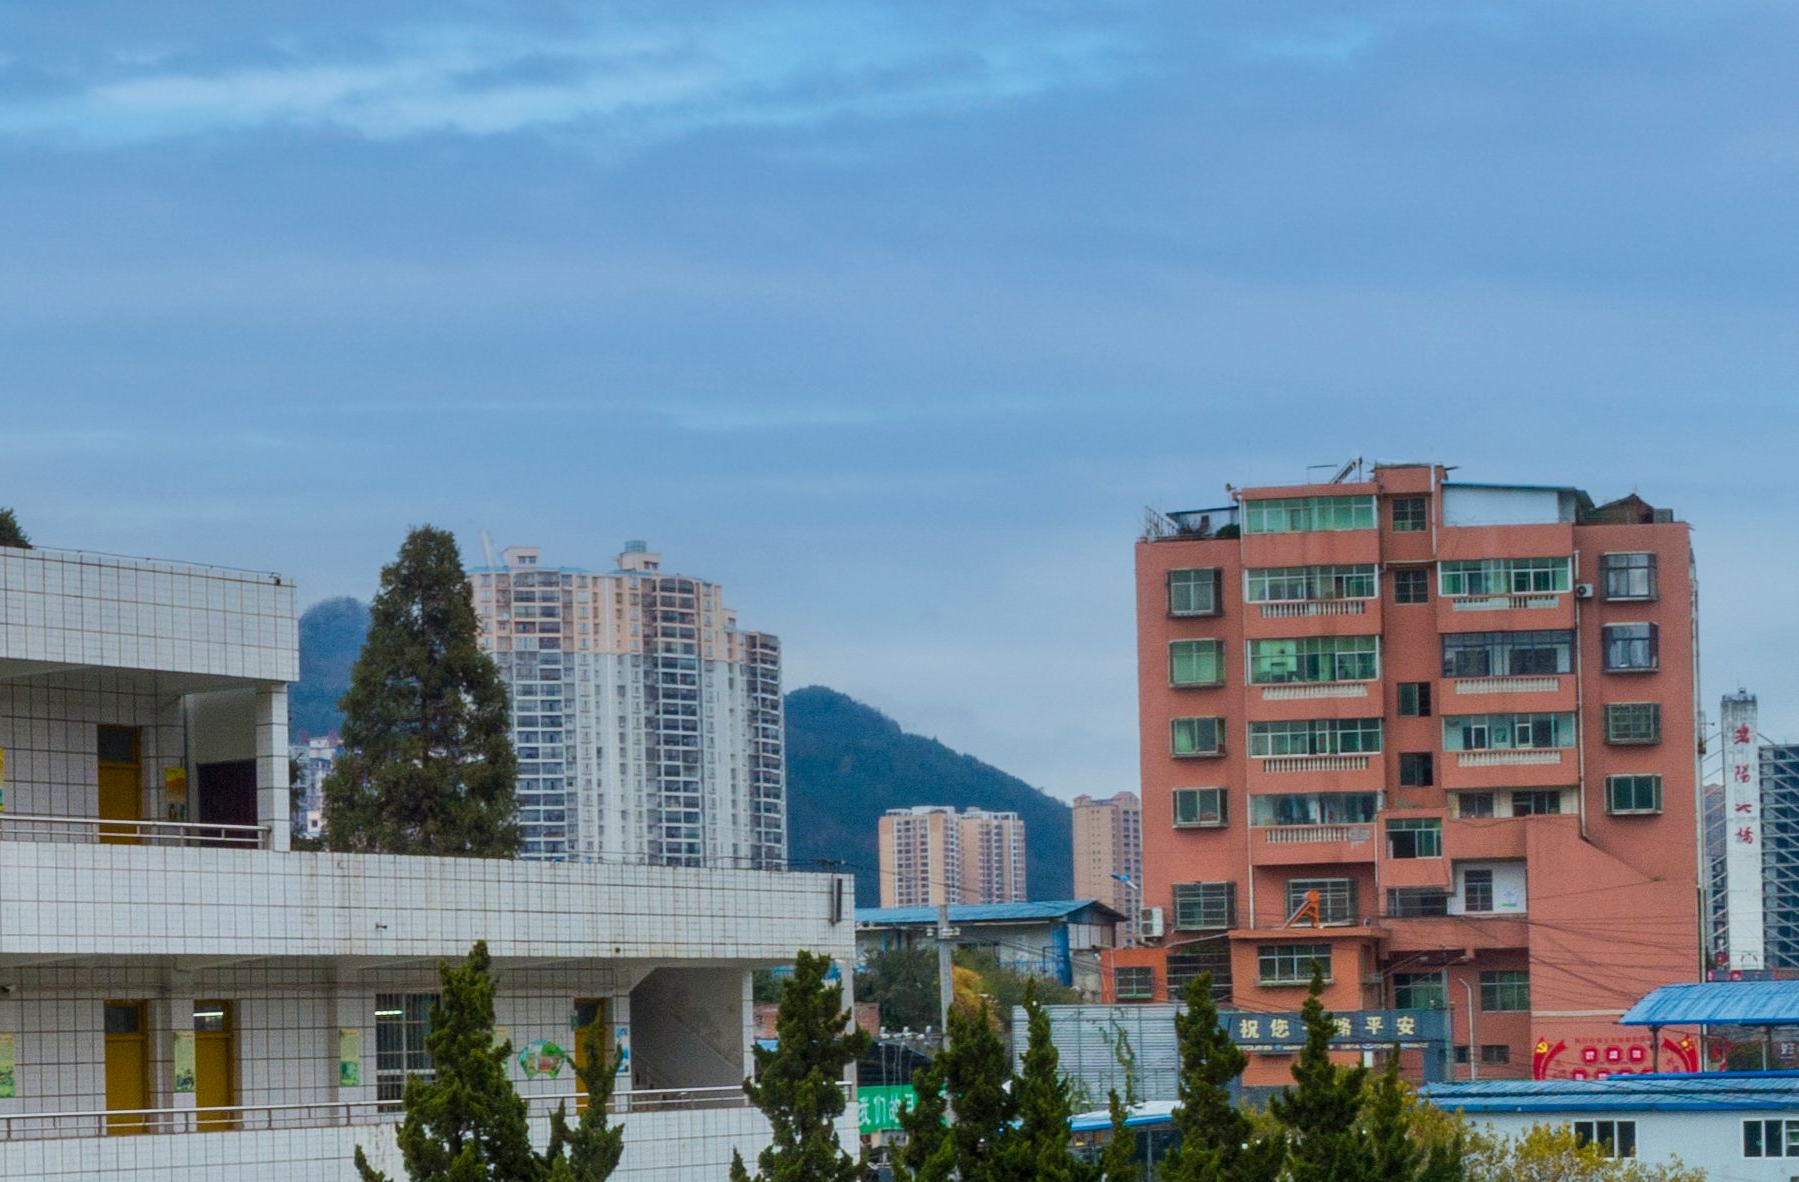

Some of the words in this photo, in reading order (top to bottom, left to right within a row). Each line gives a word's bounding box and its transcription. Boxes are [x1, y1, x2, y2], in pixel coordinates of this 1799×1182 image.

[1240, 1016, 1416, 1038] 祝您路平安
